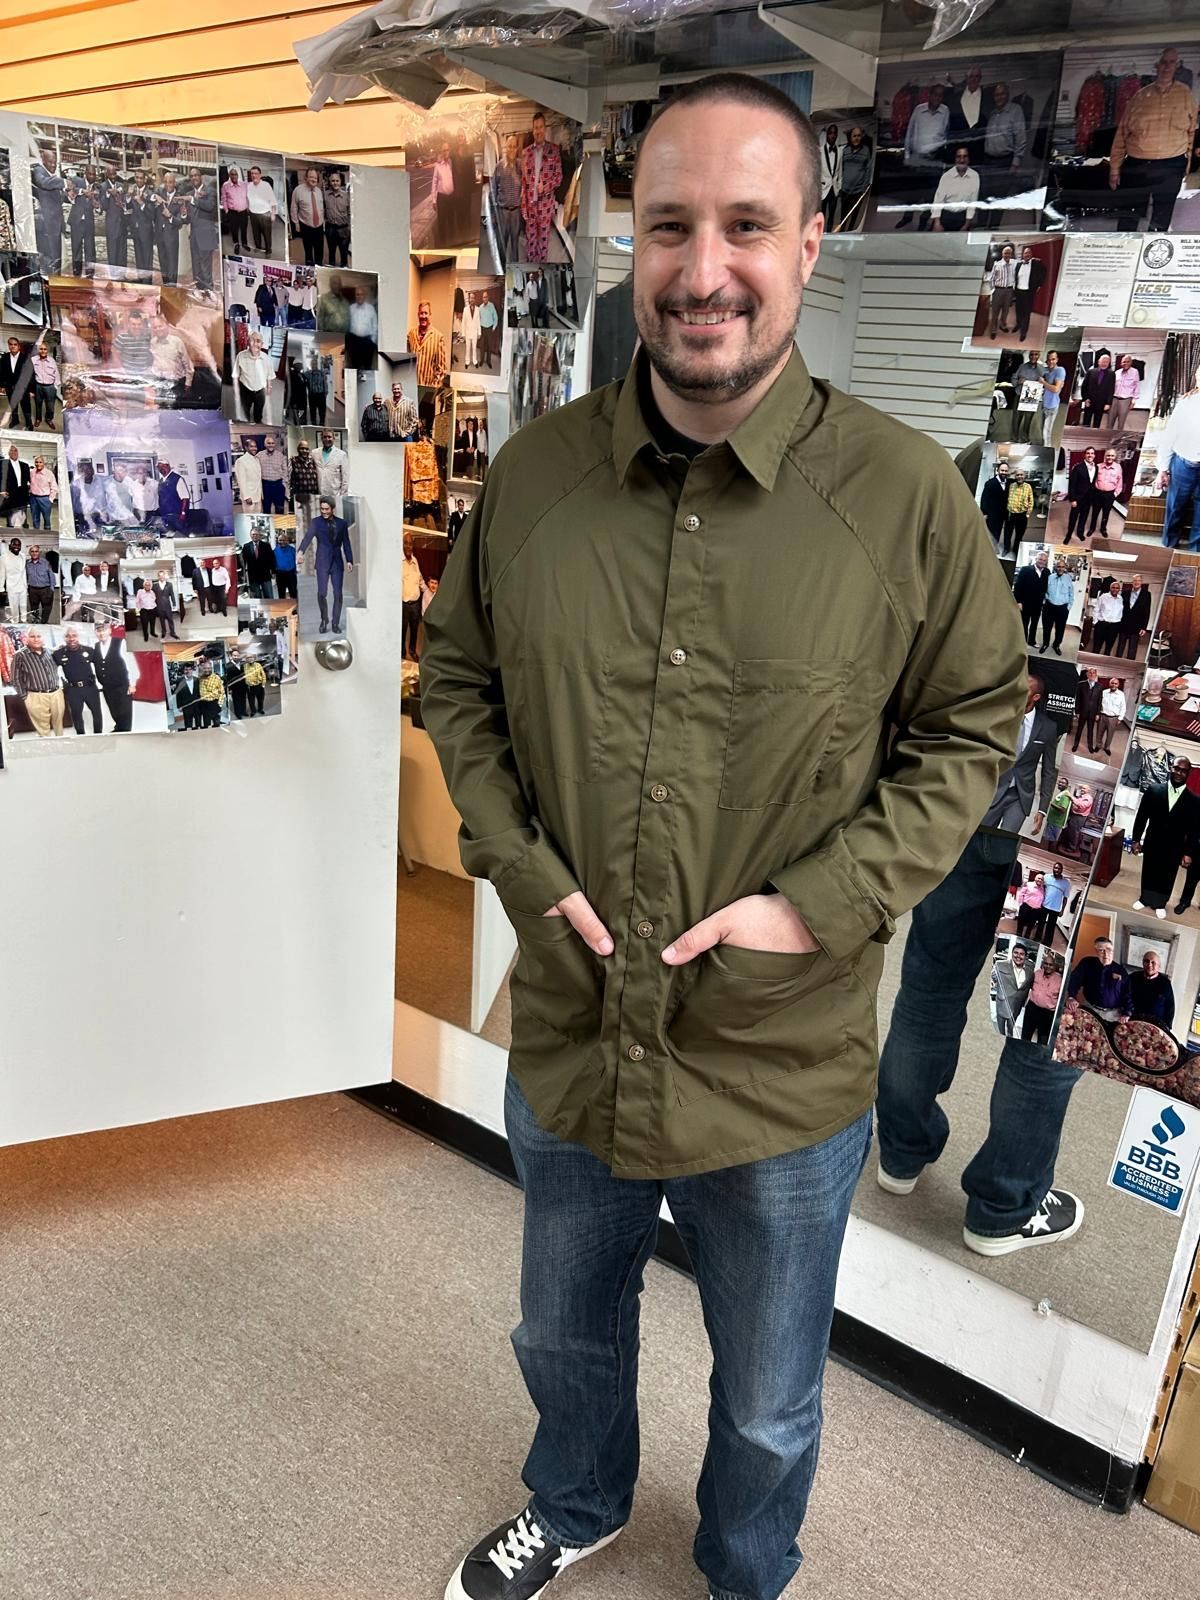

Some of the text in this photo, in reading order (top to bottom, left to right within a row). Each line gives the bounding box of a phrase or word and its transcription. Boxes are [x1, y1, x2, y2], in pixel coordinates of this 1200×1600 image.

[1135, 284, 1172, 293] HCSO
[1127, 1145, 1180, 1180] BBB
[1120, 1165, 1178, 1194] ACCREDITED
[1125, 1173, 1170, 1197] BUSINESS
